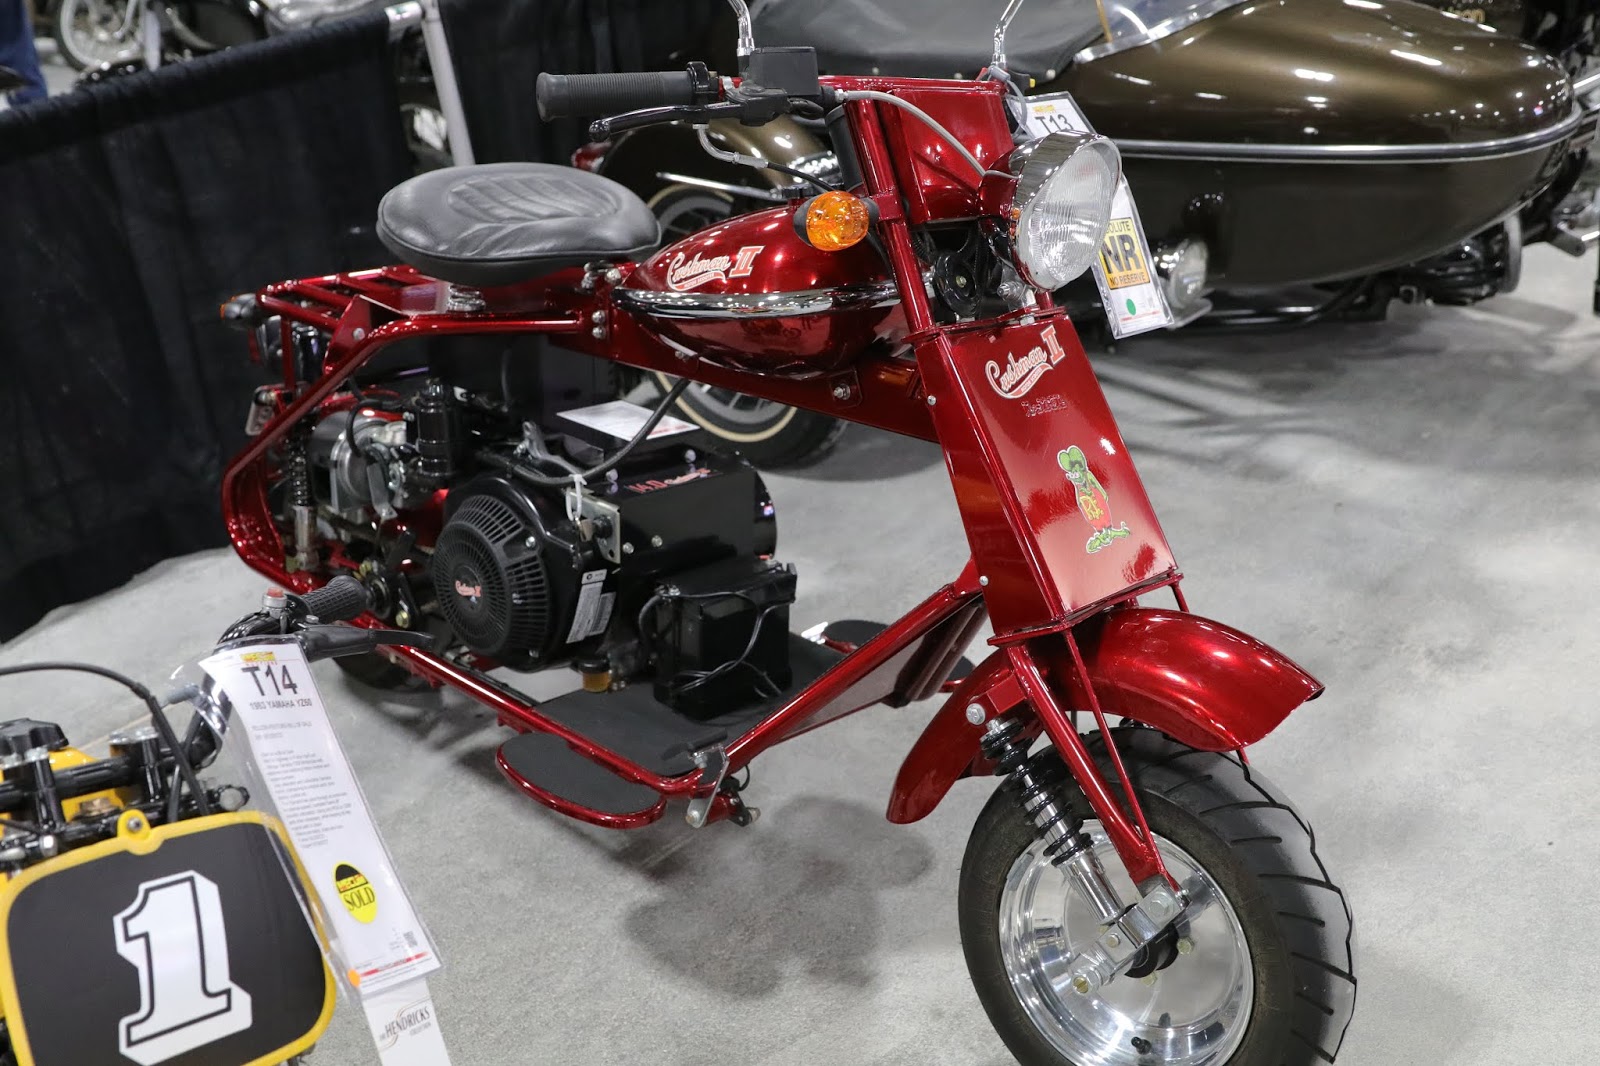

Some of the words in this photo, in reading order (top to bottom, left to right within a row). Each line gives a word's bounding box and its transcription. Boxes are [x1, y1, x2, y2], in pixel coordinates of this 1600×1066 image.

[1034, 114, 1074, 134] T13
[667, 252, 732, 292] Cushman
[729, 246, 765, 278] II
[1100, 234, 1142, 274] NR
[1109, 276, 1120, 287] NO
[1119, 272, 1147, 285] RESERVE
[985, 346, 1054, 399] Cushman
[1040, 324, 1066, 366] II
[241, 665, 298, 696] T14
[266, 699, 295, 709] YAMAHA
[343, 886, 376, 912] SOLD
[113, 870, 253, 1066] 1
[384, 1005, 431, 1038] HENDRICKS
